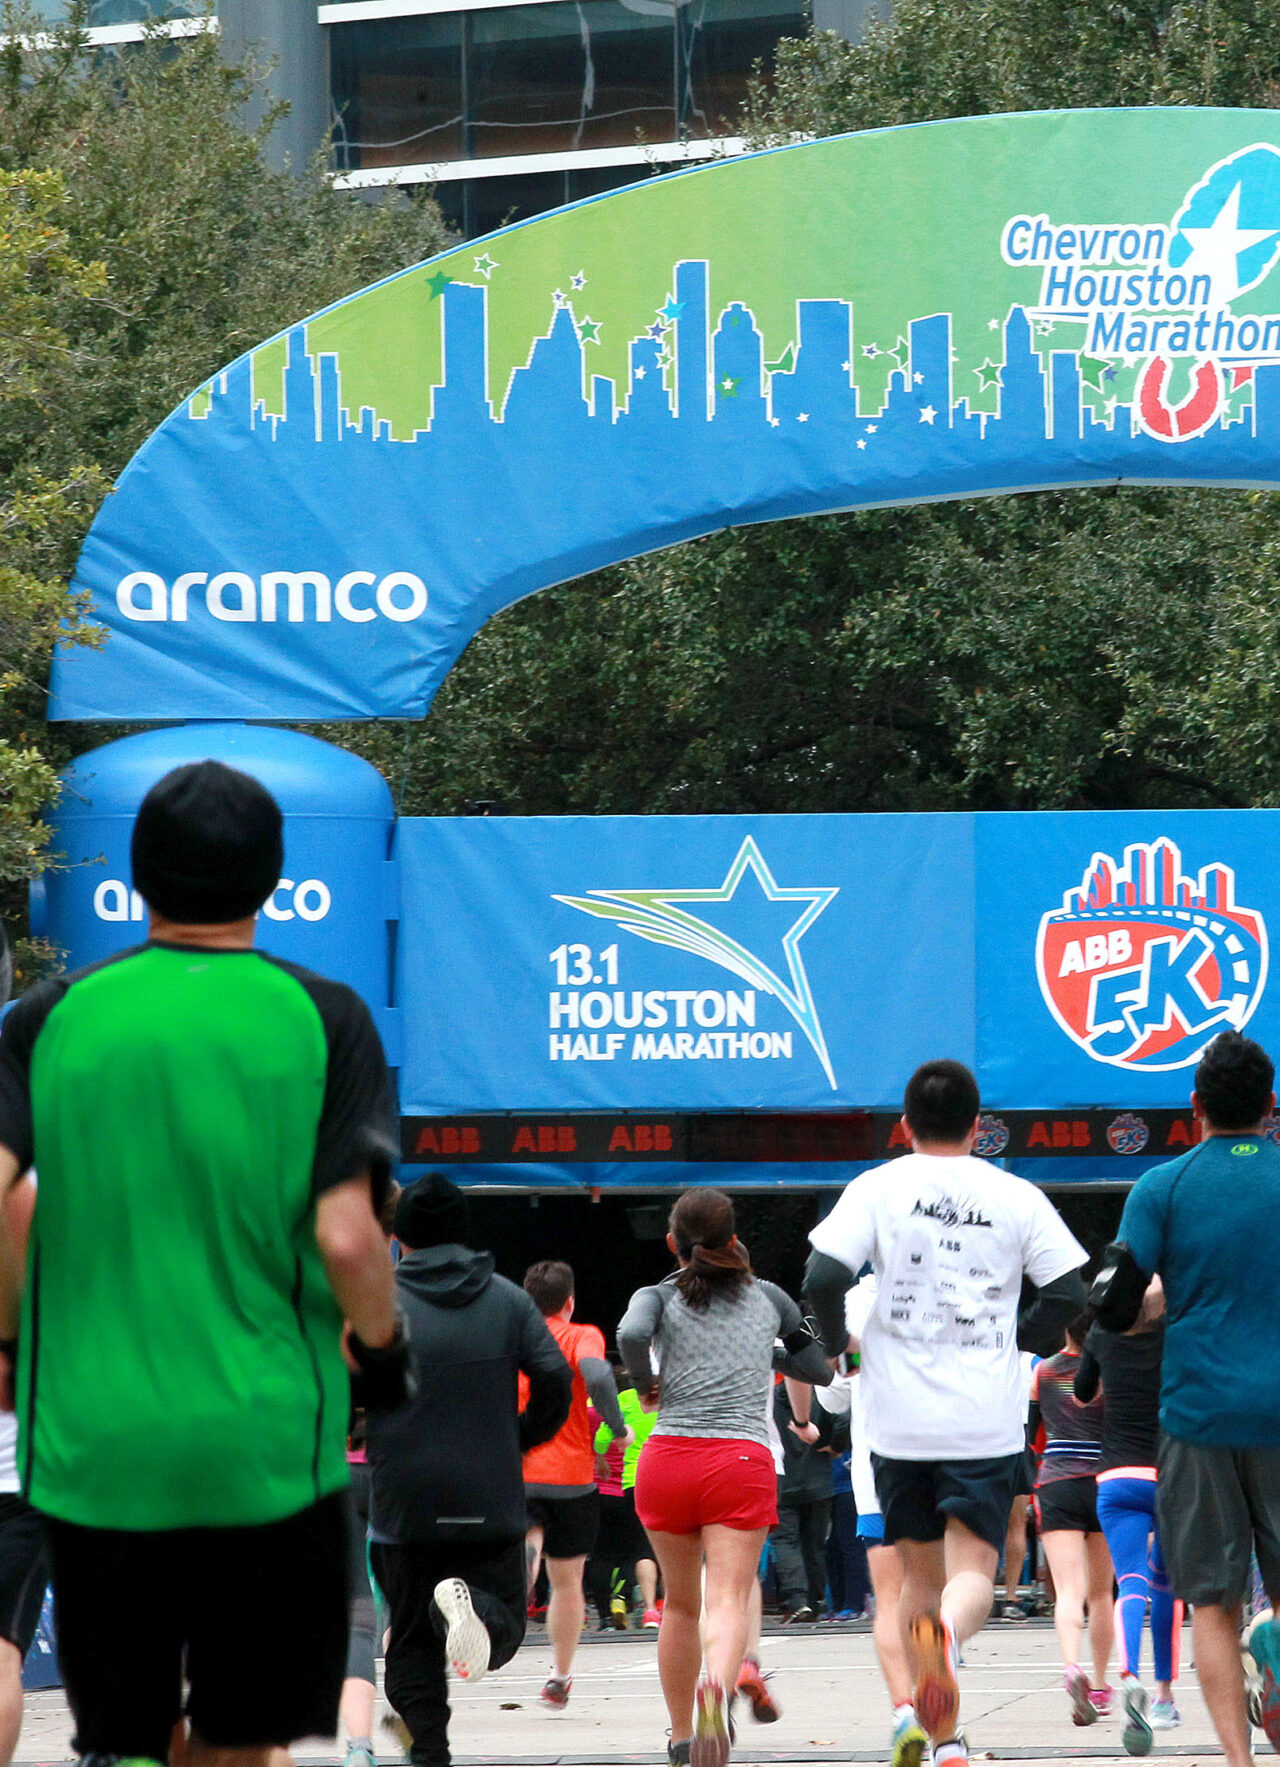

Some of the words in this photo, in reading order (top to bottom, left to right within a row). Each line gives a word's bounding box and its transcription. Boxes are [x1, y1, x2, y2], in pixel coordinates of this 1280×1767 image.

[1007, 219, 1166, 261] Chevron
[1045, 265, 1212, 307] Houston
[116, 571, 428, 623] aramco
[549, 943, 619, 985] 13.1
[1058, 929, 1133, 978] ABB
[549, 990, 756, 1029] HOUSTON
[1085, 926, 1226, 1064] 5K
[549, 1033, 626, 1061] HALF
[631, 1031, 793, 1060] MARATHON
[415, 1126, 481, 1154] ABB
[511, 1125, 577, 1153] ABB
[608, 1124, 673, 1151] ABB
[1026, 1120, 1091, 1148] ABB
